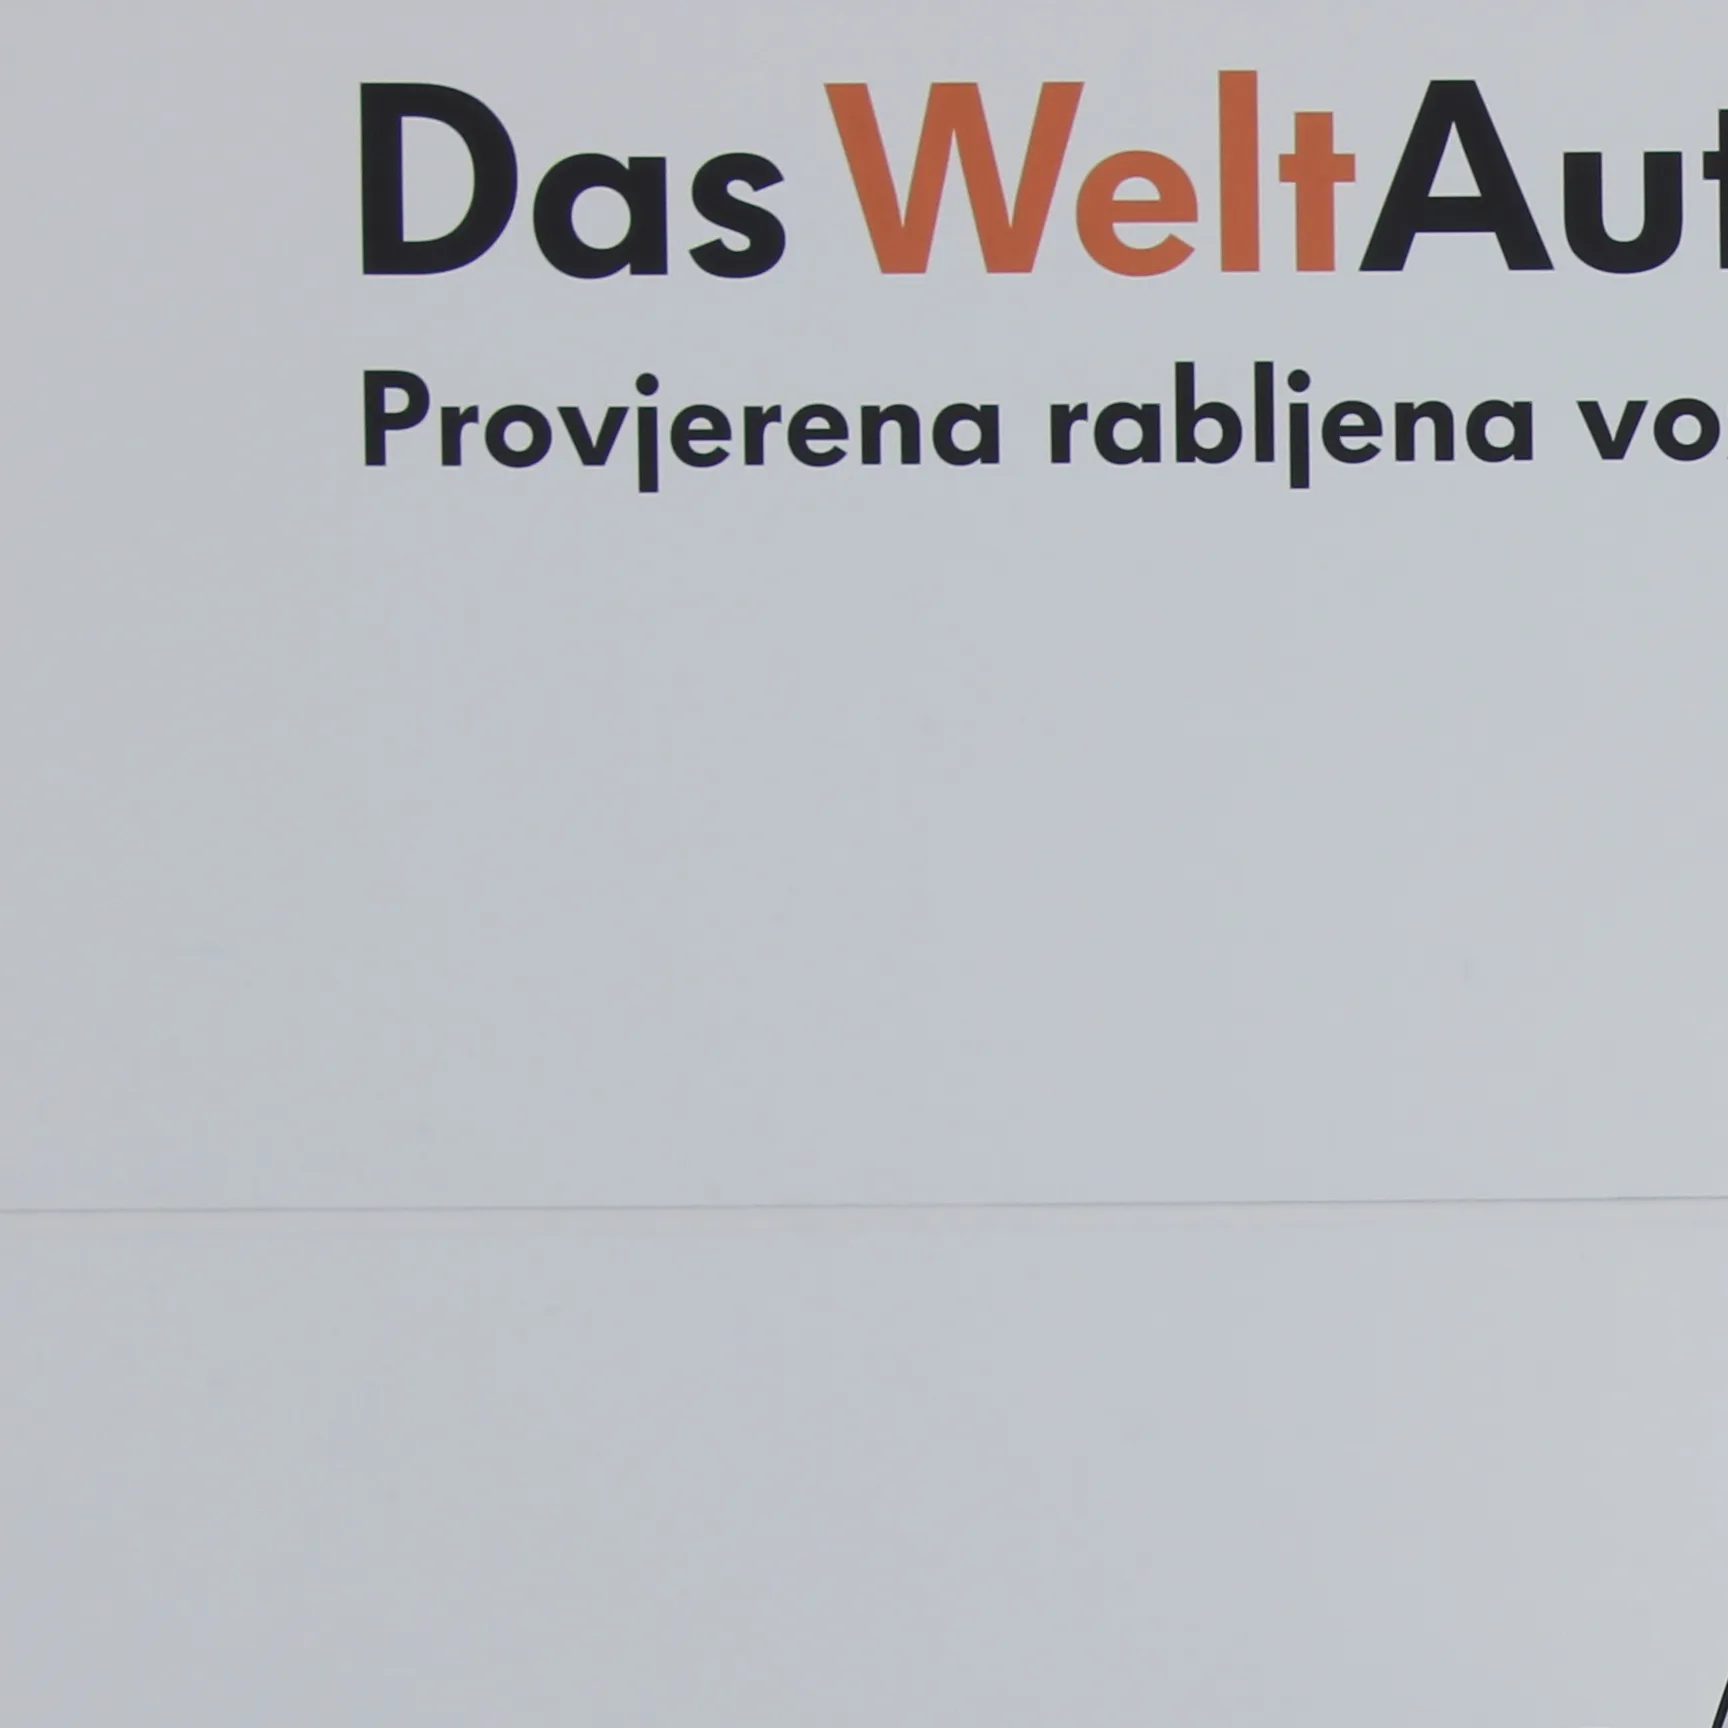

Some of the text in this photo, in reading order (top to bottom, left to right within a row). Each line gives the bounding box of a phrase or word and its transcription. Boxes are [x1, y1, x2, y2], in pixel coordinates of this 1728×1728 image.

[359, 81, 787, 281] Das
[362, 368, 1001, 494] Provjerena
[1049, 359, 1534, 490] rabljena
